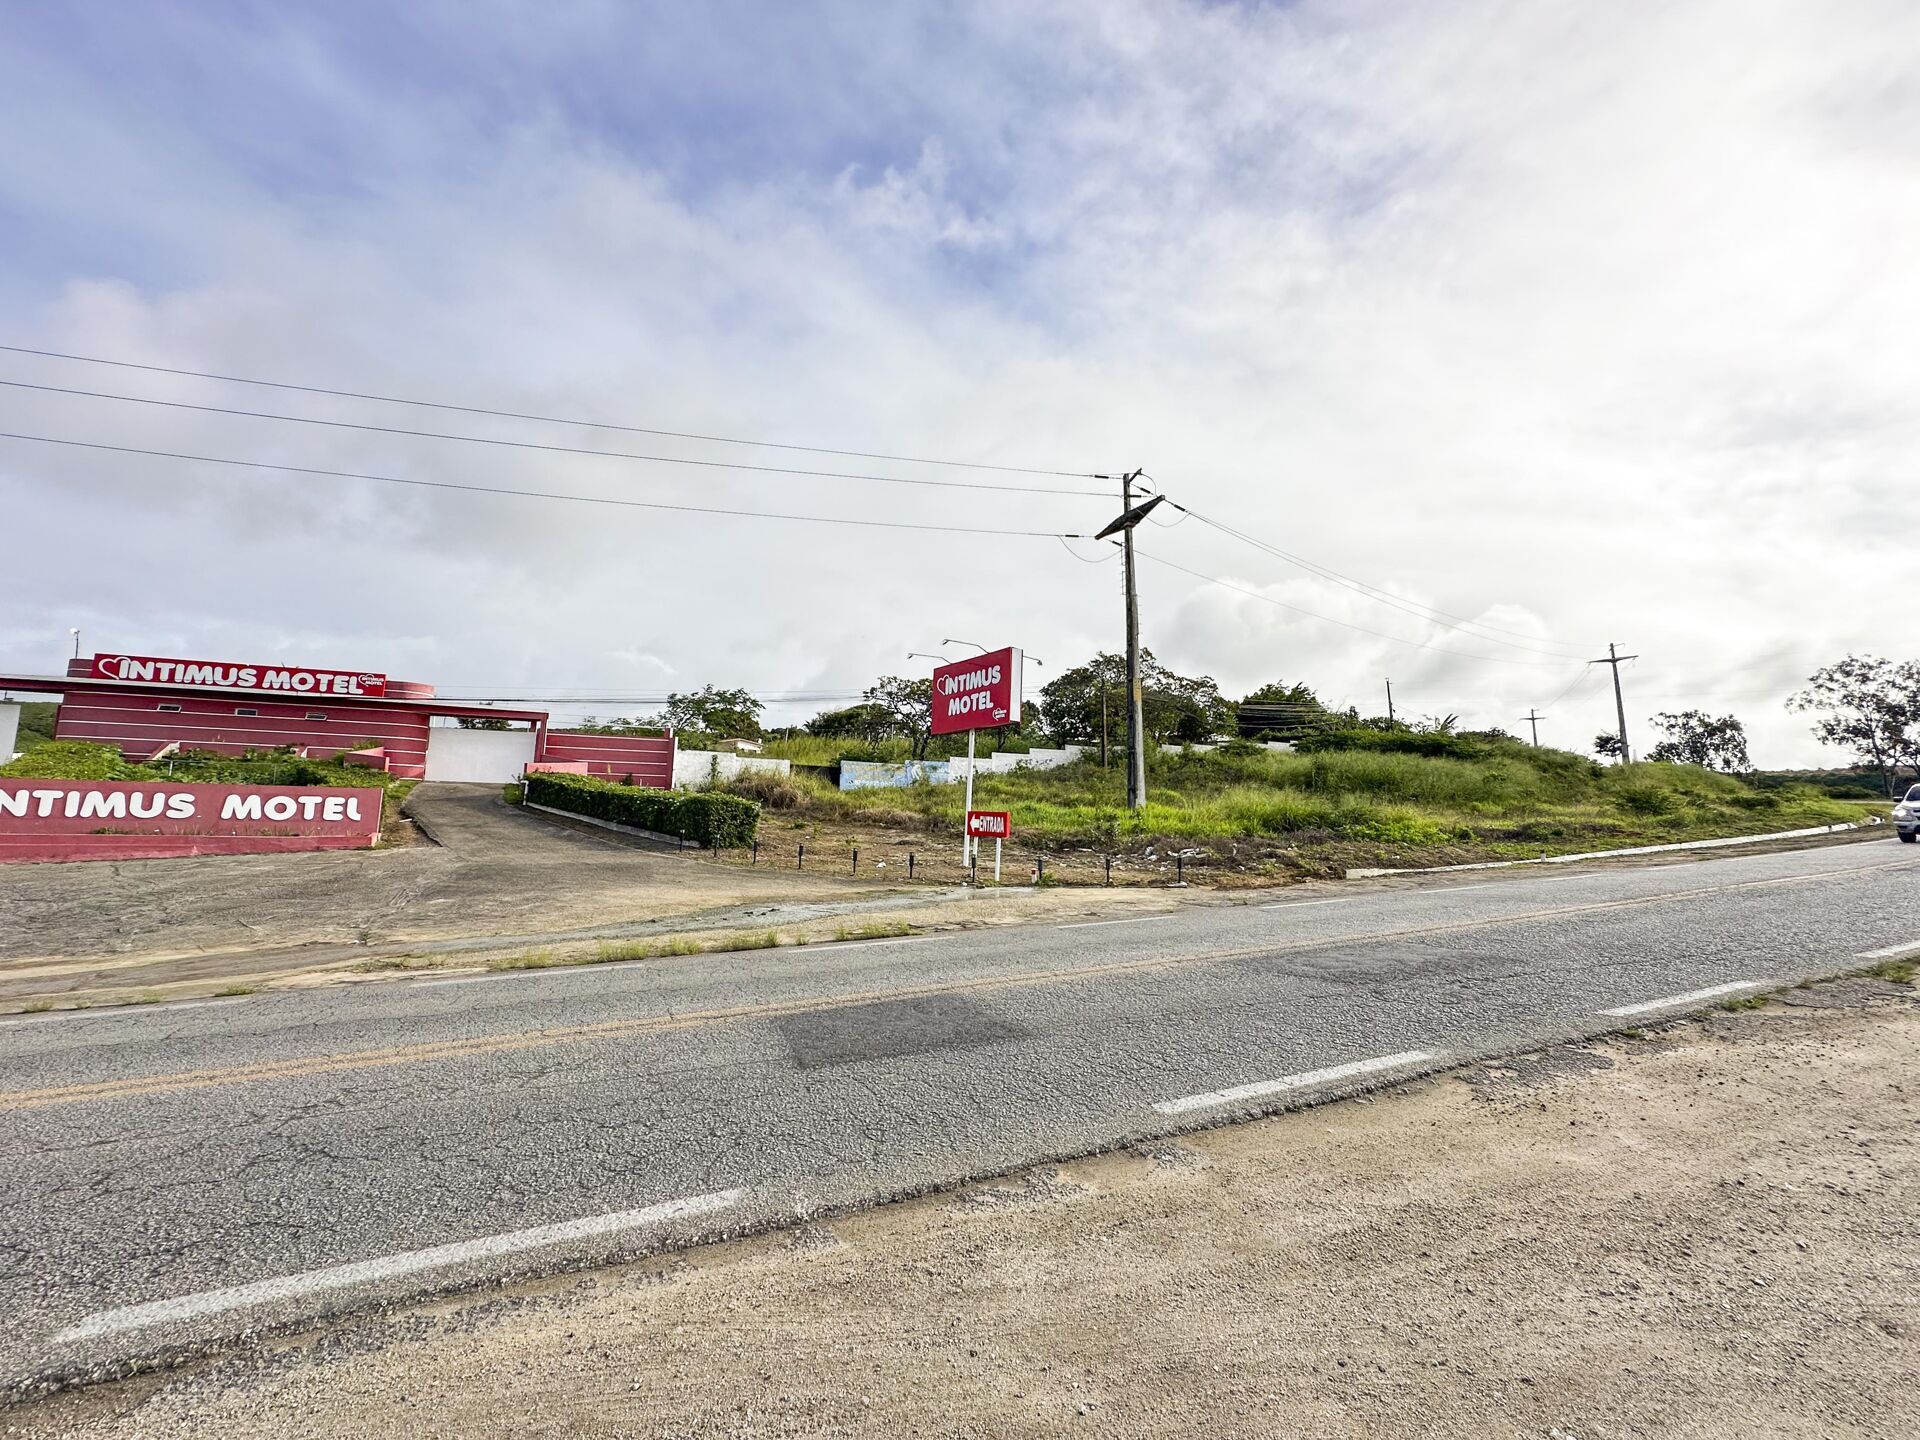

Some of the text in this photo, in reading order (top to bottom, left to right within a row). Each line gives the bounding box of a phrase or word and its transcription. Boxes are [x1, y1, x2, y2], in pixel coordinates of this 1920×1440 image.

[119, 660, 364, 694] INTIMUS MOTEL
[945, 665, 1001, 695] INTIMUS
[948, 691, 993, 716] MOTEL
[220, 794, 361, 821] MOTEL
[979, 815, 1004, 833] ENTRADA
